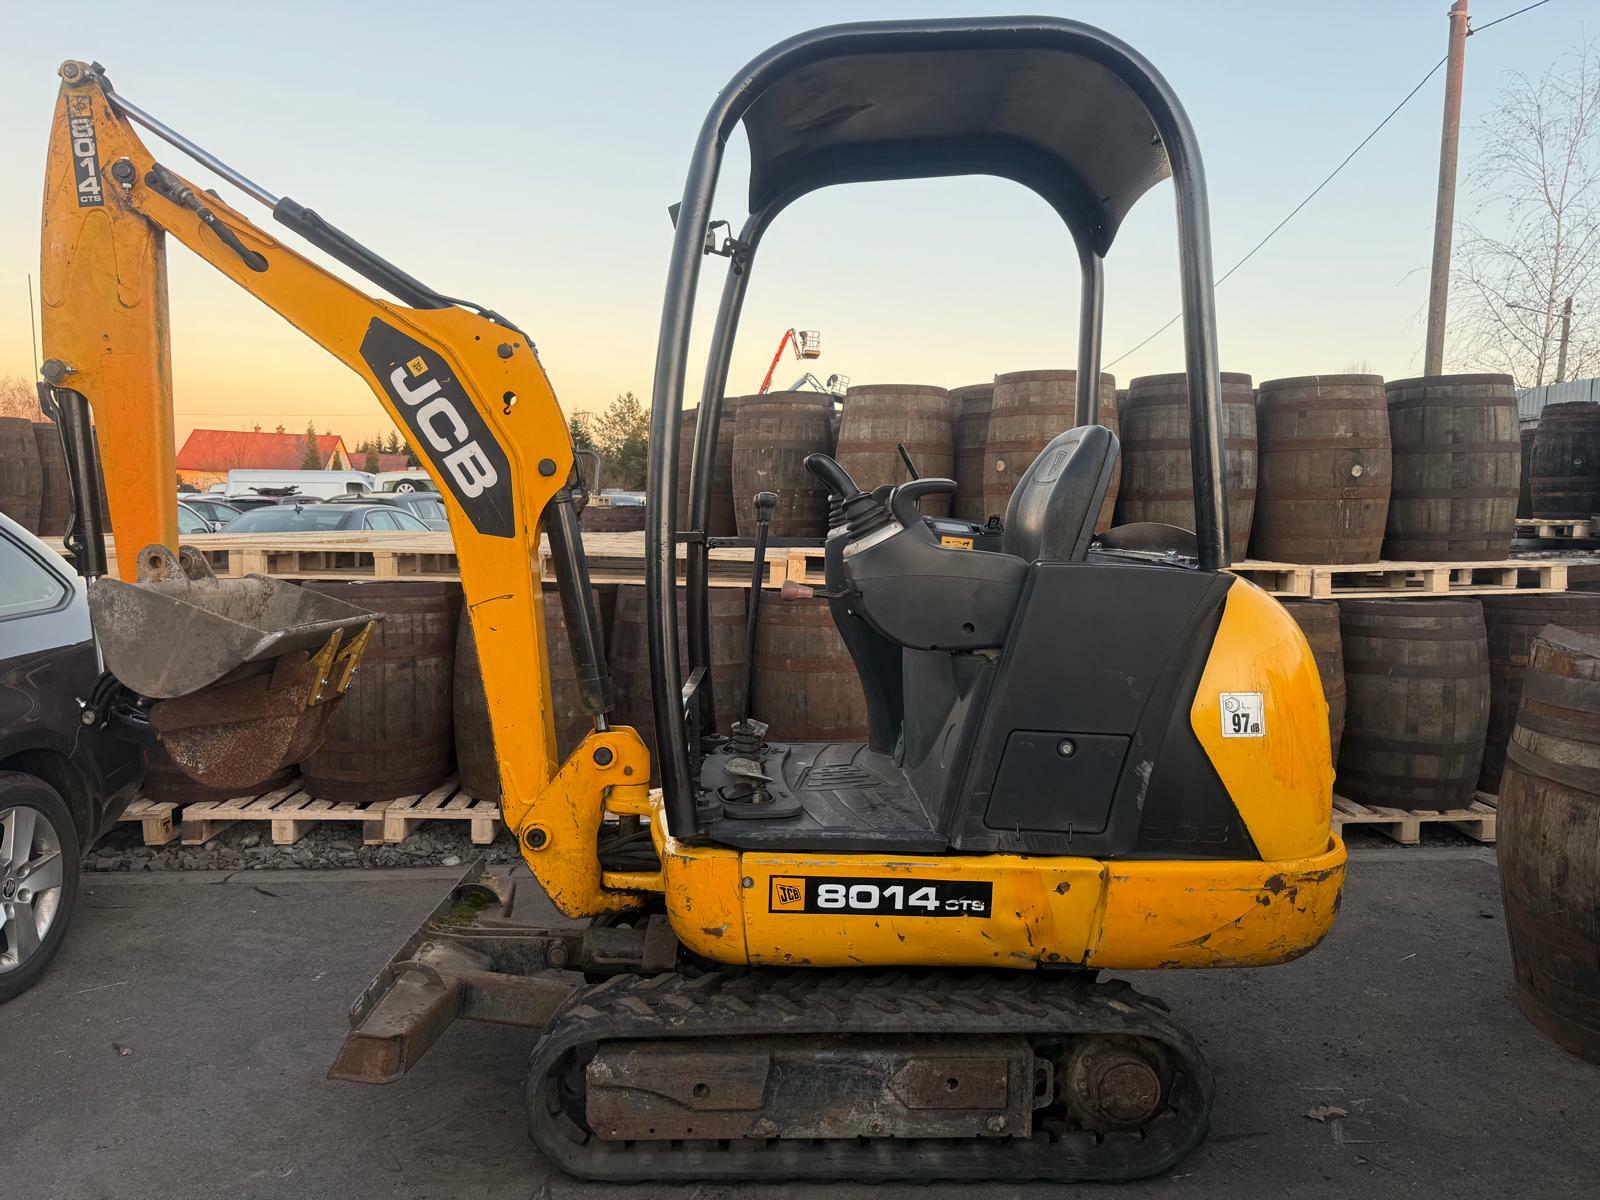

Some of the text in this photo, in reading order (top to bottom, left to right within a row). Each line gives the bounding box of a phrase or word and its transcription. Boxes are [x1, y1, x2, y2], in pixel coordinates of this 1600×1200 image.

[71, 118, 100, 195] 8014
[390, 366, 498, 498] JCB
[1232, 713, 1260, 733] 97 dB
[778, 885, 801, 904] JCB
[817, 884, 985, 911] 8014 CTS
